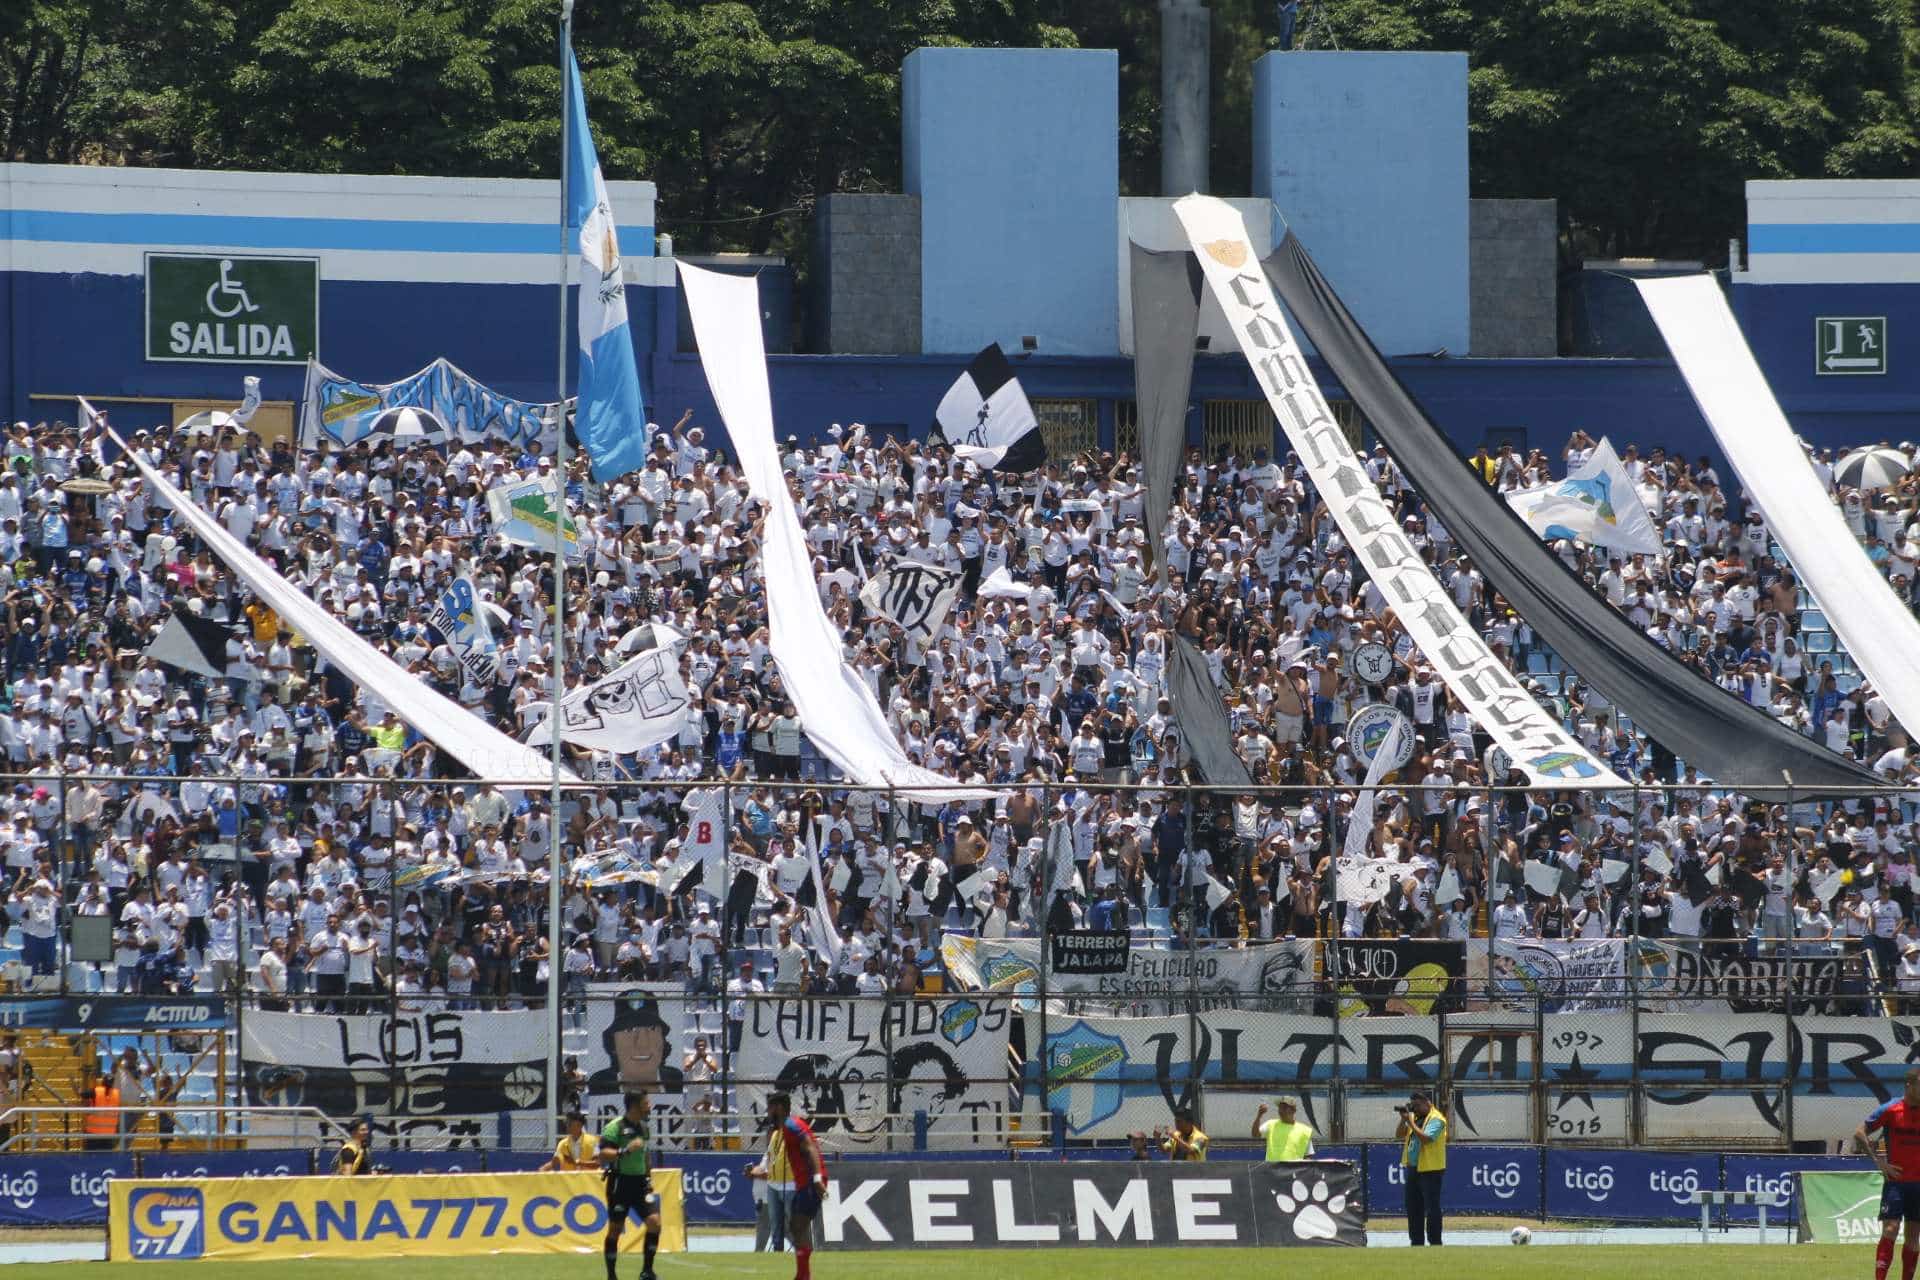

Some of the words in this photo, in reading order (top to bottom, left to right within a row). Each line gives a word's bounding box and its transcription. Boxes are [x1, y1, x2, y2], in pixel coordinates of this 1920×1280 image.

[169, 321, 295, 357] SALIDA
[1056, 935, 1128, 949] TERRERO
[1058, 952, 1125, 968] JALAPA
[78, 1004, 92, 1023] 9
[145, 1005, 209, 1023] ACTITUD
[337, 1012, 463, 1066] LOS
[1552, 1031, 1604, 1051] 1997
[0, 1170, 38, 1208] igo
[218, 1193, 661, 1243] GANA777.CO
[823, 1179, 1238, 1242] KELME
